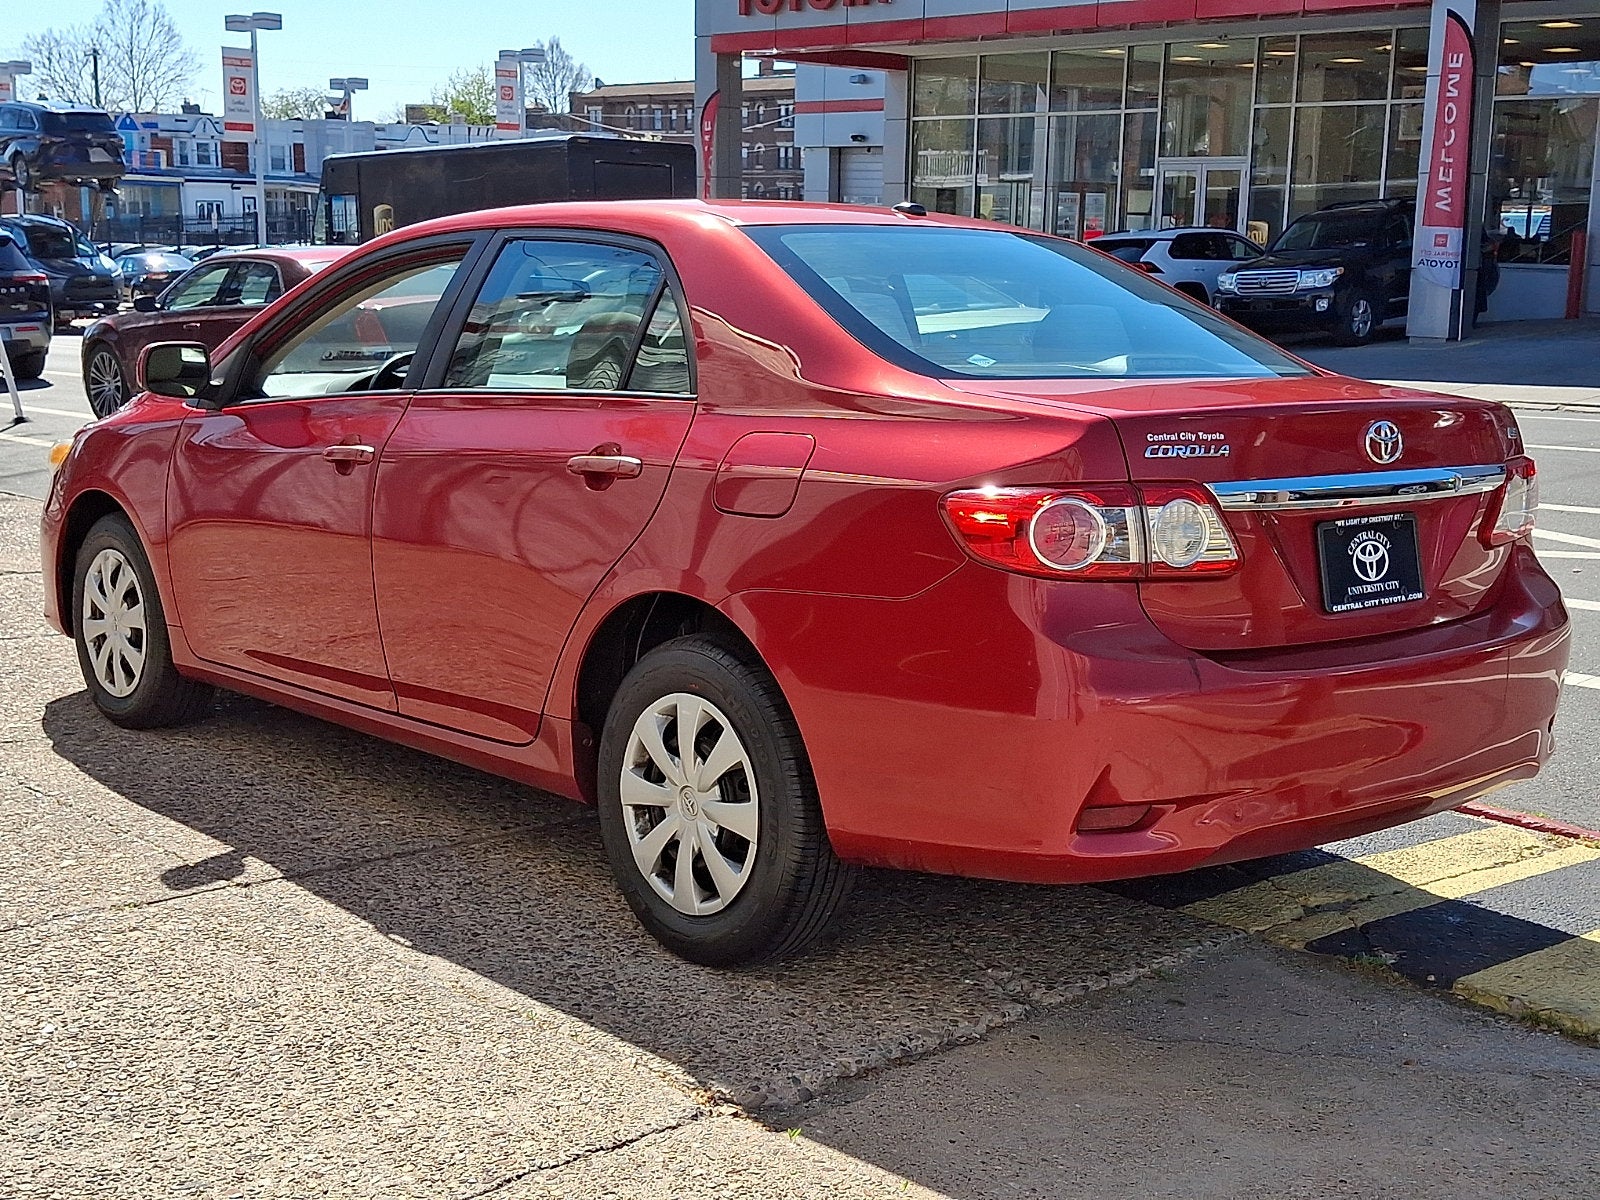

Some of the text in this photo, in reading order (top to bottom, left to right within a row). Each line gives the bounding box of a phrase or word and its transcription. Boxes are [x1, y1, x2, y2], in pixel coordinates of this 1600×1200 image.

[1147, 431, 1225, 442] Central City Toyota
[1145, 444, 1230, 459] COROLLA
[1347, 530, 1392, 556] CENTRAL CITY
[1347, 580, 1400, 596] UNIVERSITY CITY
[1332, 592, 1423, 612] CENTRAL CITY TOYOTA .COM
